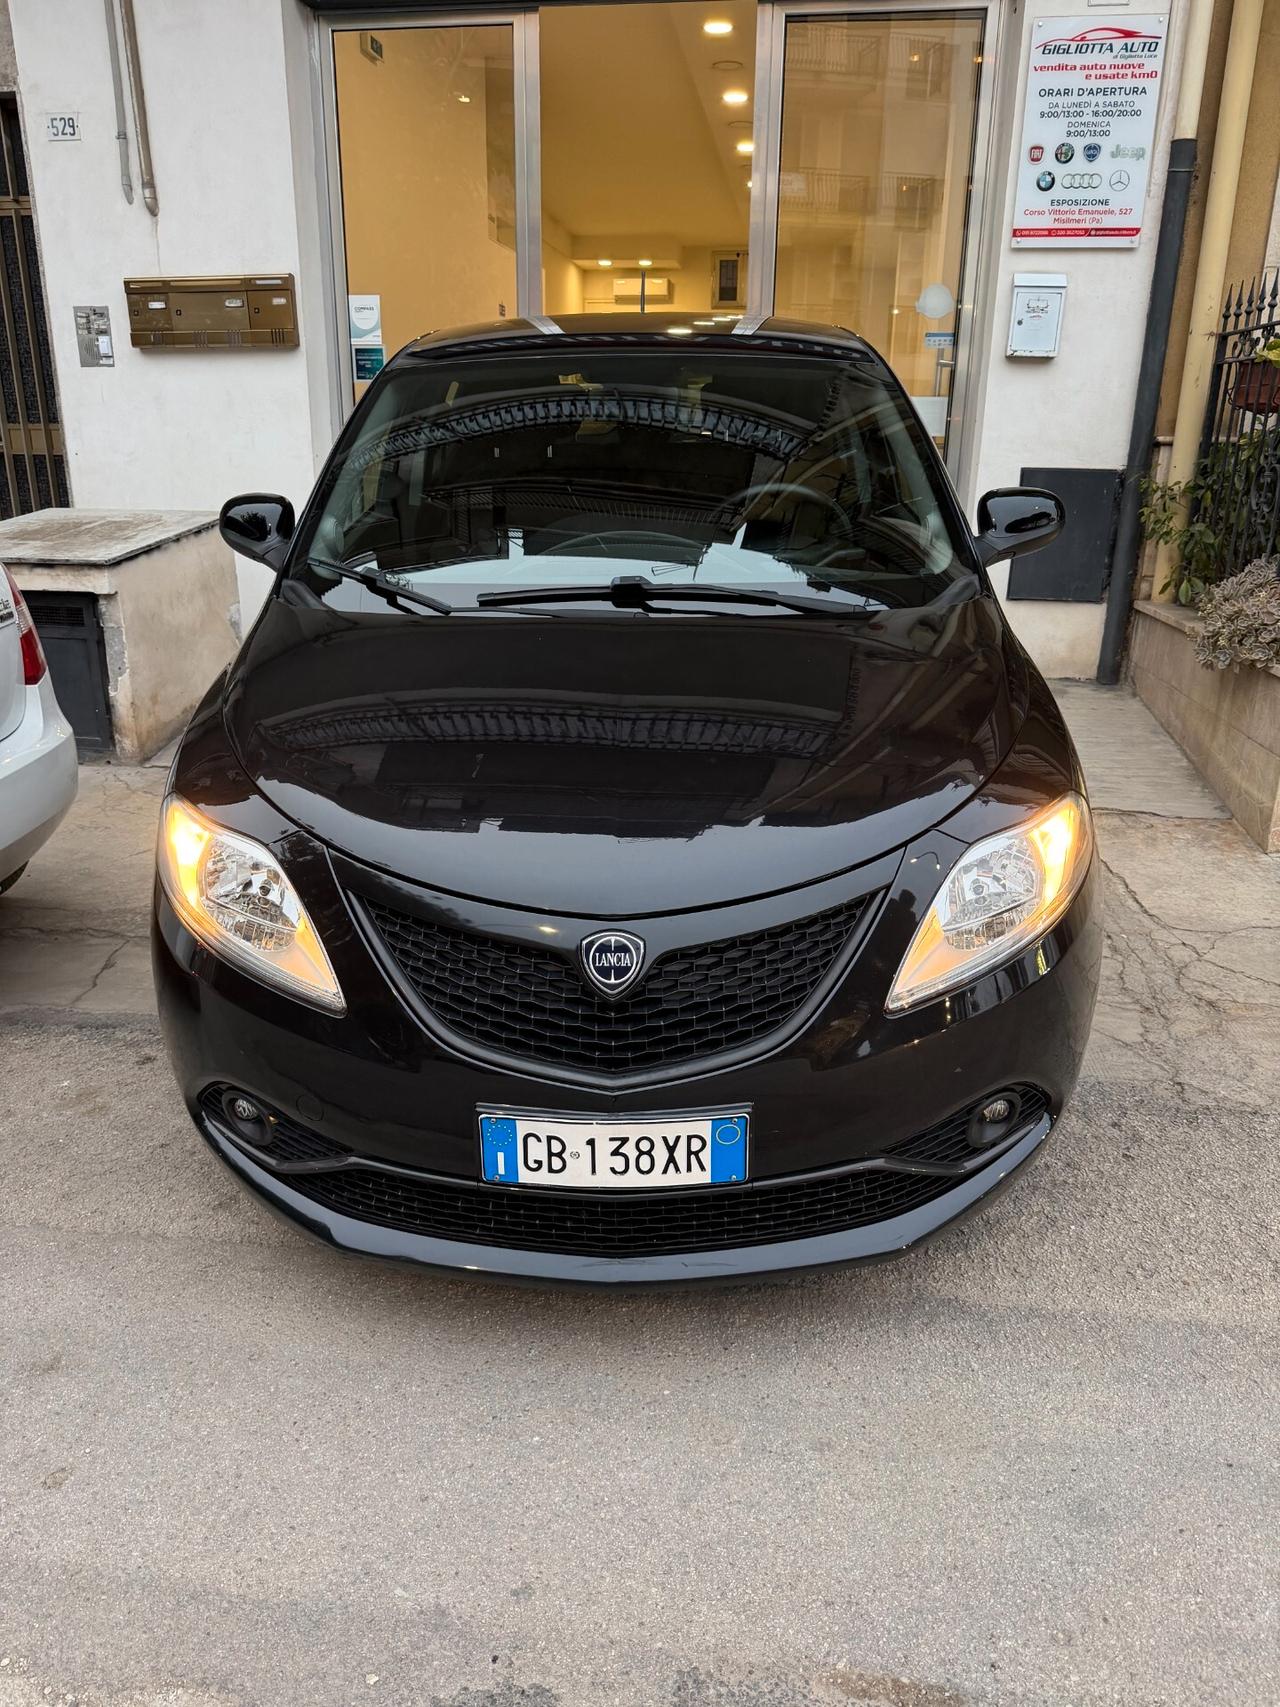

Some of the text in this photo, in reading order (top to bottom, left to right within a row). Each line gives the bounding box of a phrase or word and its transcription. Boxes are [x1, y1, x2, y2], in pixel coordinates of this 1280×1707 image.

[1042, 42, 1158, 55] GIGLIOTTA AUTO
[1033, 62, 1145, 72] vendita auto nuove
[1094, 72, 1128, 80] usate
[1038, 86, 1147, 97] ORARI D'APERTURA
[1048, 101, 1060, 109] DA
[1062, 100, 1092, 109] LUNEDÌ
[1102, 100, 1136, 108] SABATO
[1040, 110, 1084, 119] 9:00/13:00
[1091, 109, 1142, 118] 16:00/20:00
[1067, 121, 1111, 129] DOMENICA
[1066, 129, 1111, 138] 9:00/13:00
[1110, 144, 1146, 161] Jeep
[1050, 199, 1110, 207] ESPOSIZIONE
[1048, 208, 1076, 216] Vittorio
[1078, 208, 1117, 216] Emanuele,
[1053, 217, 1103, 225] Misilmeri (Pa)
[595, 952, 632, 967] LANCIA
